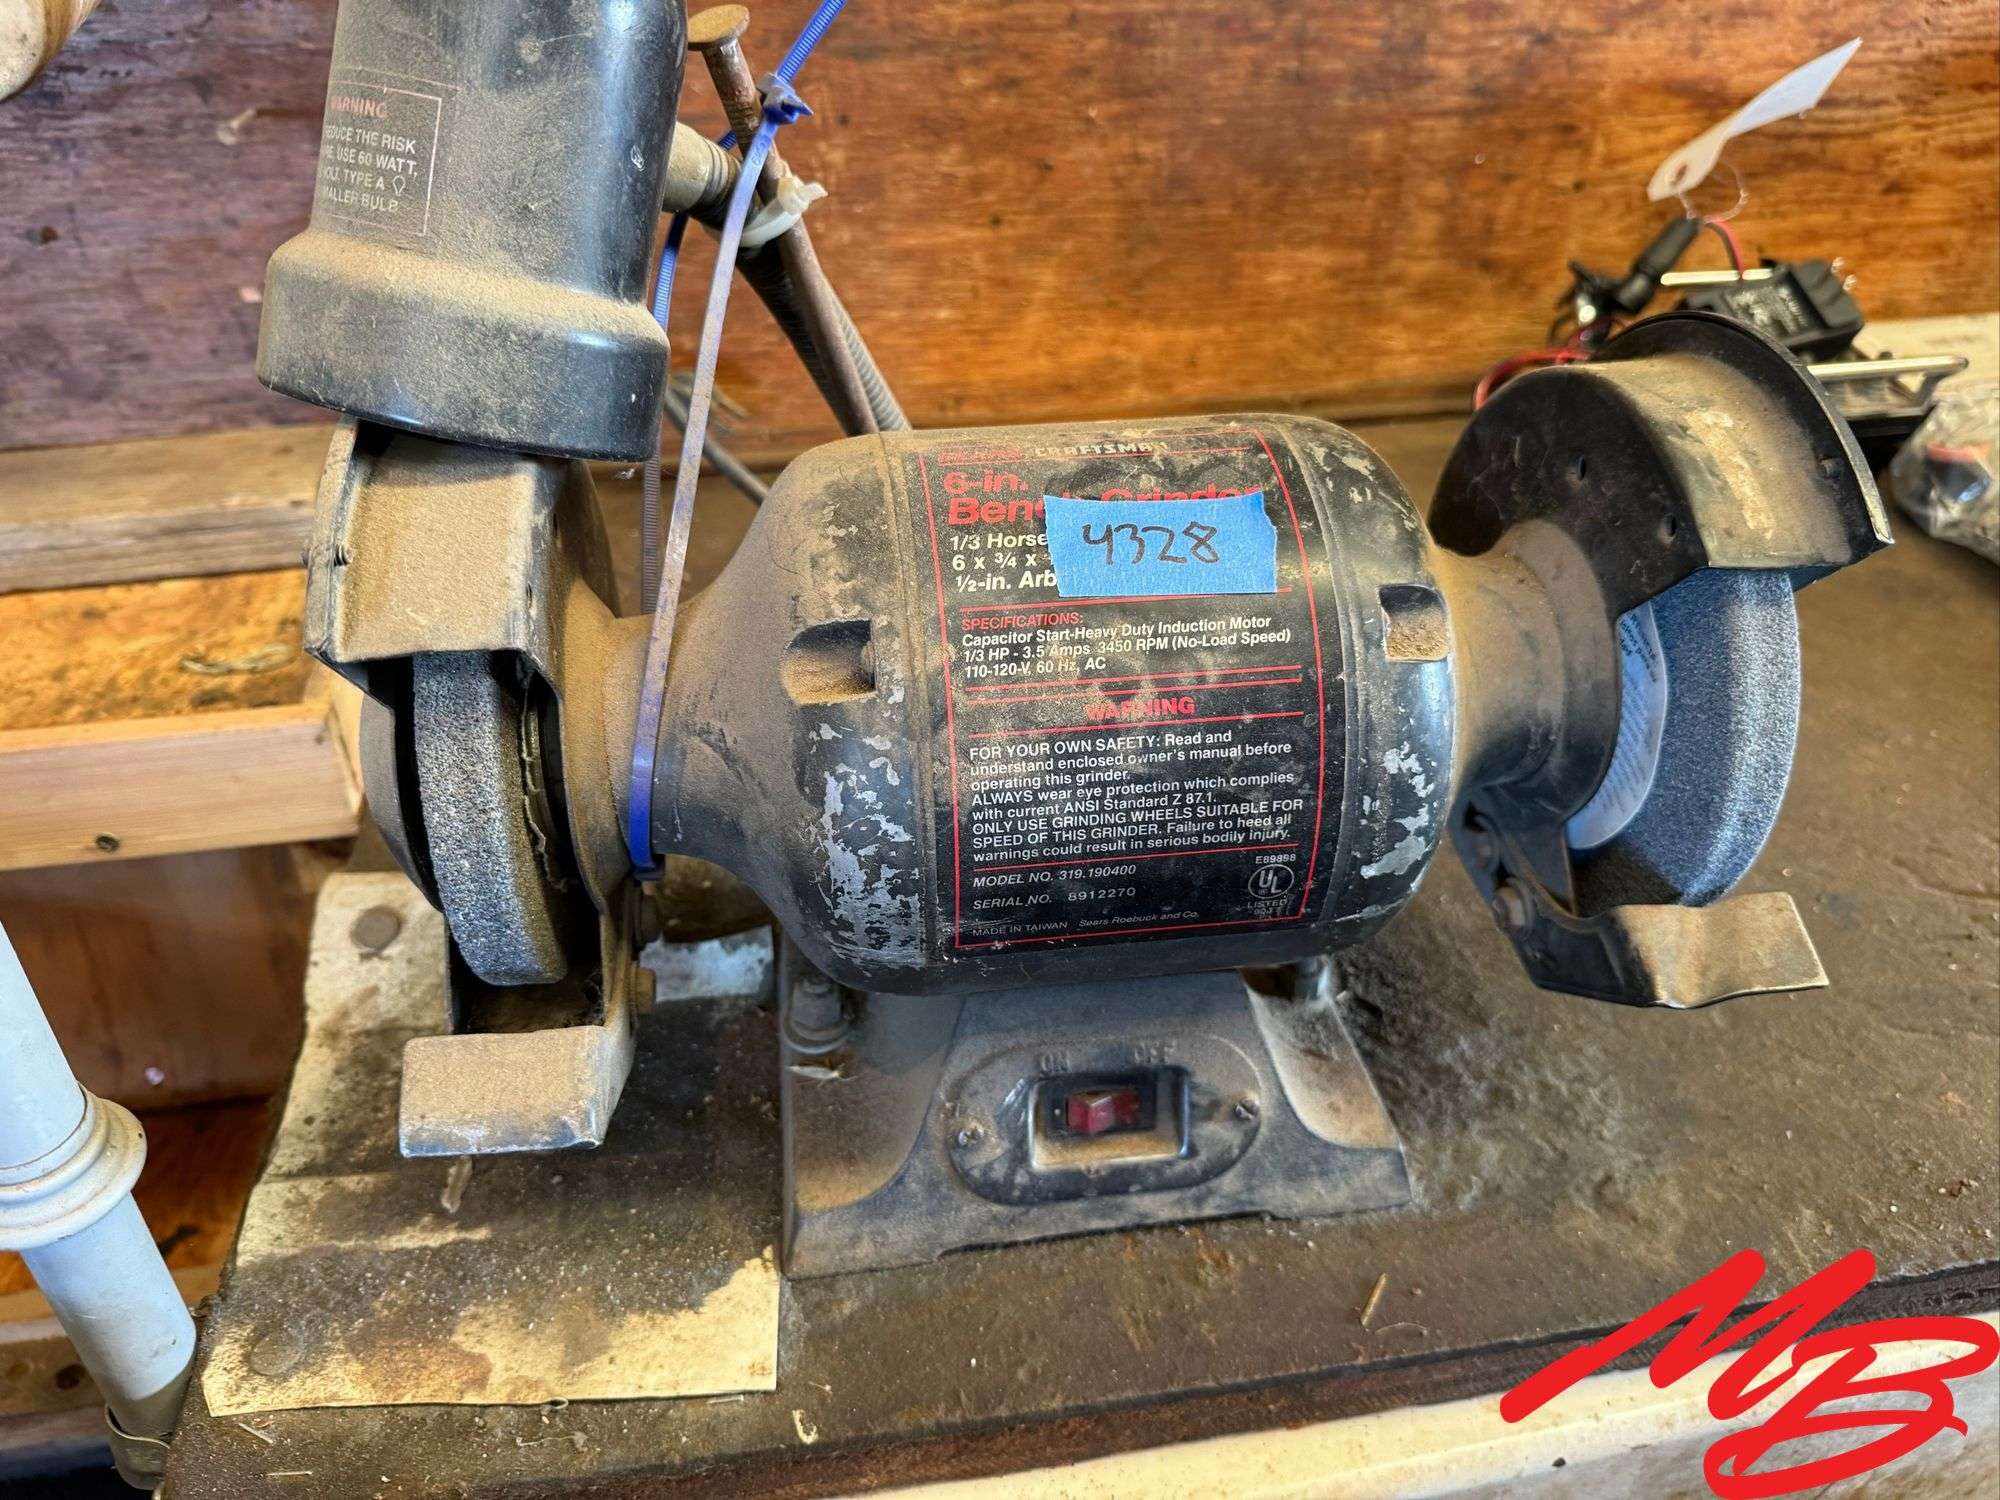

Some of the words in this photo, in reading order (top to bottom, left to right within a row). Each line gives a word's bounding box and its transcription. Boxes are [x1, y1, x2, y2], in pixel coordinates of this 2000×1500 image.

[355, 128, 380, 145] THE
[381, 133, 416, 154] RISK
[336, 146, 357, 163] USE
[358, 150, 372, 166] 60
[375, 153, 418, 179] WATT,
[343, 169, 373, 187] TYPE
[375, 176, 386, 190] A
[326, 185, 359, 204] ALLER
[943, 470, 1028, 494] 6-in.
[950, 535, 981, 551] 1/3
[1082, 521, 1220, 565] 4328
[952, 554, 966, 571] 6
[974, 556, 986, 570] x
[1025, 552, 1037, 567] x
[961, 611, 1083, 631] SPECIFICATIONS:
[962, 631, 1032, 649] Capacitor
[1036, 625, 1118, 643] Start-Heavy
[1121, 622, 1154, 638] Duty
[1158, 619, 1226, 635] Induction
[1230, 616, 1271, 631] Motor
[964, 649, 984, 663] 1/3
[989, 647, 1010, 661] HP
[1022, 645, 1045, 659] 3.5
[1098, 640, 1131, 654] 3450
[1136, 637, 1168, 651] RPM
[1171, 632, 1237, 650] (No-Load
[1241, 628, 1291, 647] Speed)
[1036, 660, 1054, 674] 60
[1085, 657, 1106, 671] AC
[1086, 696, 1196, 720] WARNING
[970, 743, 1001, 760] FOR
[1006, 742, 1050, 758] YOUR
[1054, 739, 1091, 755] OWN
[1096, 734, 1161, 751] SAFETY:
[1165, 731, 1202, 747] Read
[1205, 730, 1232, 743] and
[970, 758, 1054, 776] understand
[1057, 753, 1124, 770] enclosed
[1128, 749, 1186, 765] owner's
[1190, 745, 1241, 760] manual
[1245, 741, 1292, 756] before
[971, 776, 1041, 793] operating
[1045, 772, 1072, 786] this
[1076, 769, 1131, 786] grinder.
[971, 789, 1034, 807] ALWAYS
[1038, 788, 1073, 802] wear
[1076, 787, 1102, 800] eye
[1106, 780, 1180, 798] protection
[1184, 776, 1226, 791] which
[1230, 772, 1295, 788] complies
[972, 807, 1003, 821] with
[1007, 804, 1061, 818] current
[1064, 800, 1100, 814] ANSI
[1104, 795, 1168, 810] Standard
[1172, 793, 1182, 806] Z
[1185, 791, 1217, 805] 87.1.
[972, 820, 1013, 835] ONLY
[1018, 818, 1048, 832] USE
[1052, 812, 1127, 829] GRINDING
[1131, 807, 1193, 823] WHEELS
[1196, 801, 1269, 818] SUITABLE
[1273, 798, 1304, 812] FOR
[973, 834, 1023, 849] SPEED
[1027, 831, 1048, 845] OF
[1052, 829, 1087, 843] THIS
[1091, 823, 1162, 840] GRINDER.
[1167, 819, 1215, 834] Failure
[1219, 818, 1233, 830] to
[1237, 814, 1271, 828] heed
[1275, 813, 1292, 826] all
[973, 848, 1039, 862] warnings
[1043, 842, 1082, 856] could
[1086, 839, 1127, 853] result
[1130, 838, 1143, 850] in
[1147, 835, 1199, 849] serious
[1202, 830, 1245, 845] bodily
[1249, 829, 1291, 843] injury.
[973, 873, 1025, 888] MODEL
[1028, 871, 1054, 883] NO.
[1059, 864, 1137, 881] 319.190400
[1258, 869, 1283, 894] UL
[973, 896, 1024, 910] SERIAL
[1027, 894, 1053, 906] NO.
[1247, 899, 1288, 909] LISTED
[972, 926, 1009, 937] MADE
[1010, 924, 1022, 933] IN
[1025, 921, 1069, 932] TAIWAN
[1079, 918, 1109, 928] Sears
[1112, 913, 1157, 925] Roebuck
[1160, 911, 1182, 920] and
